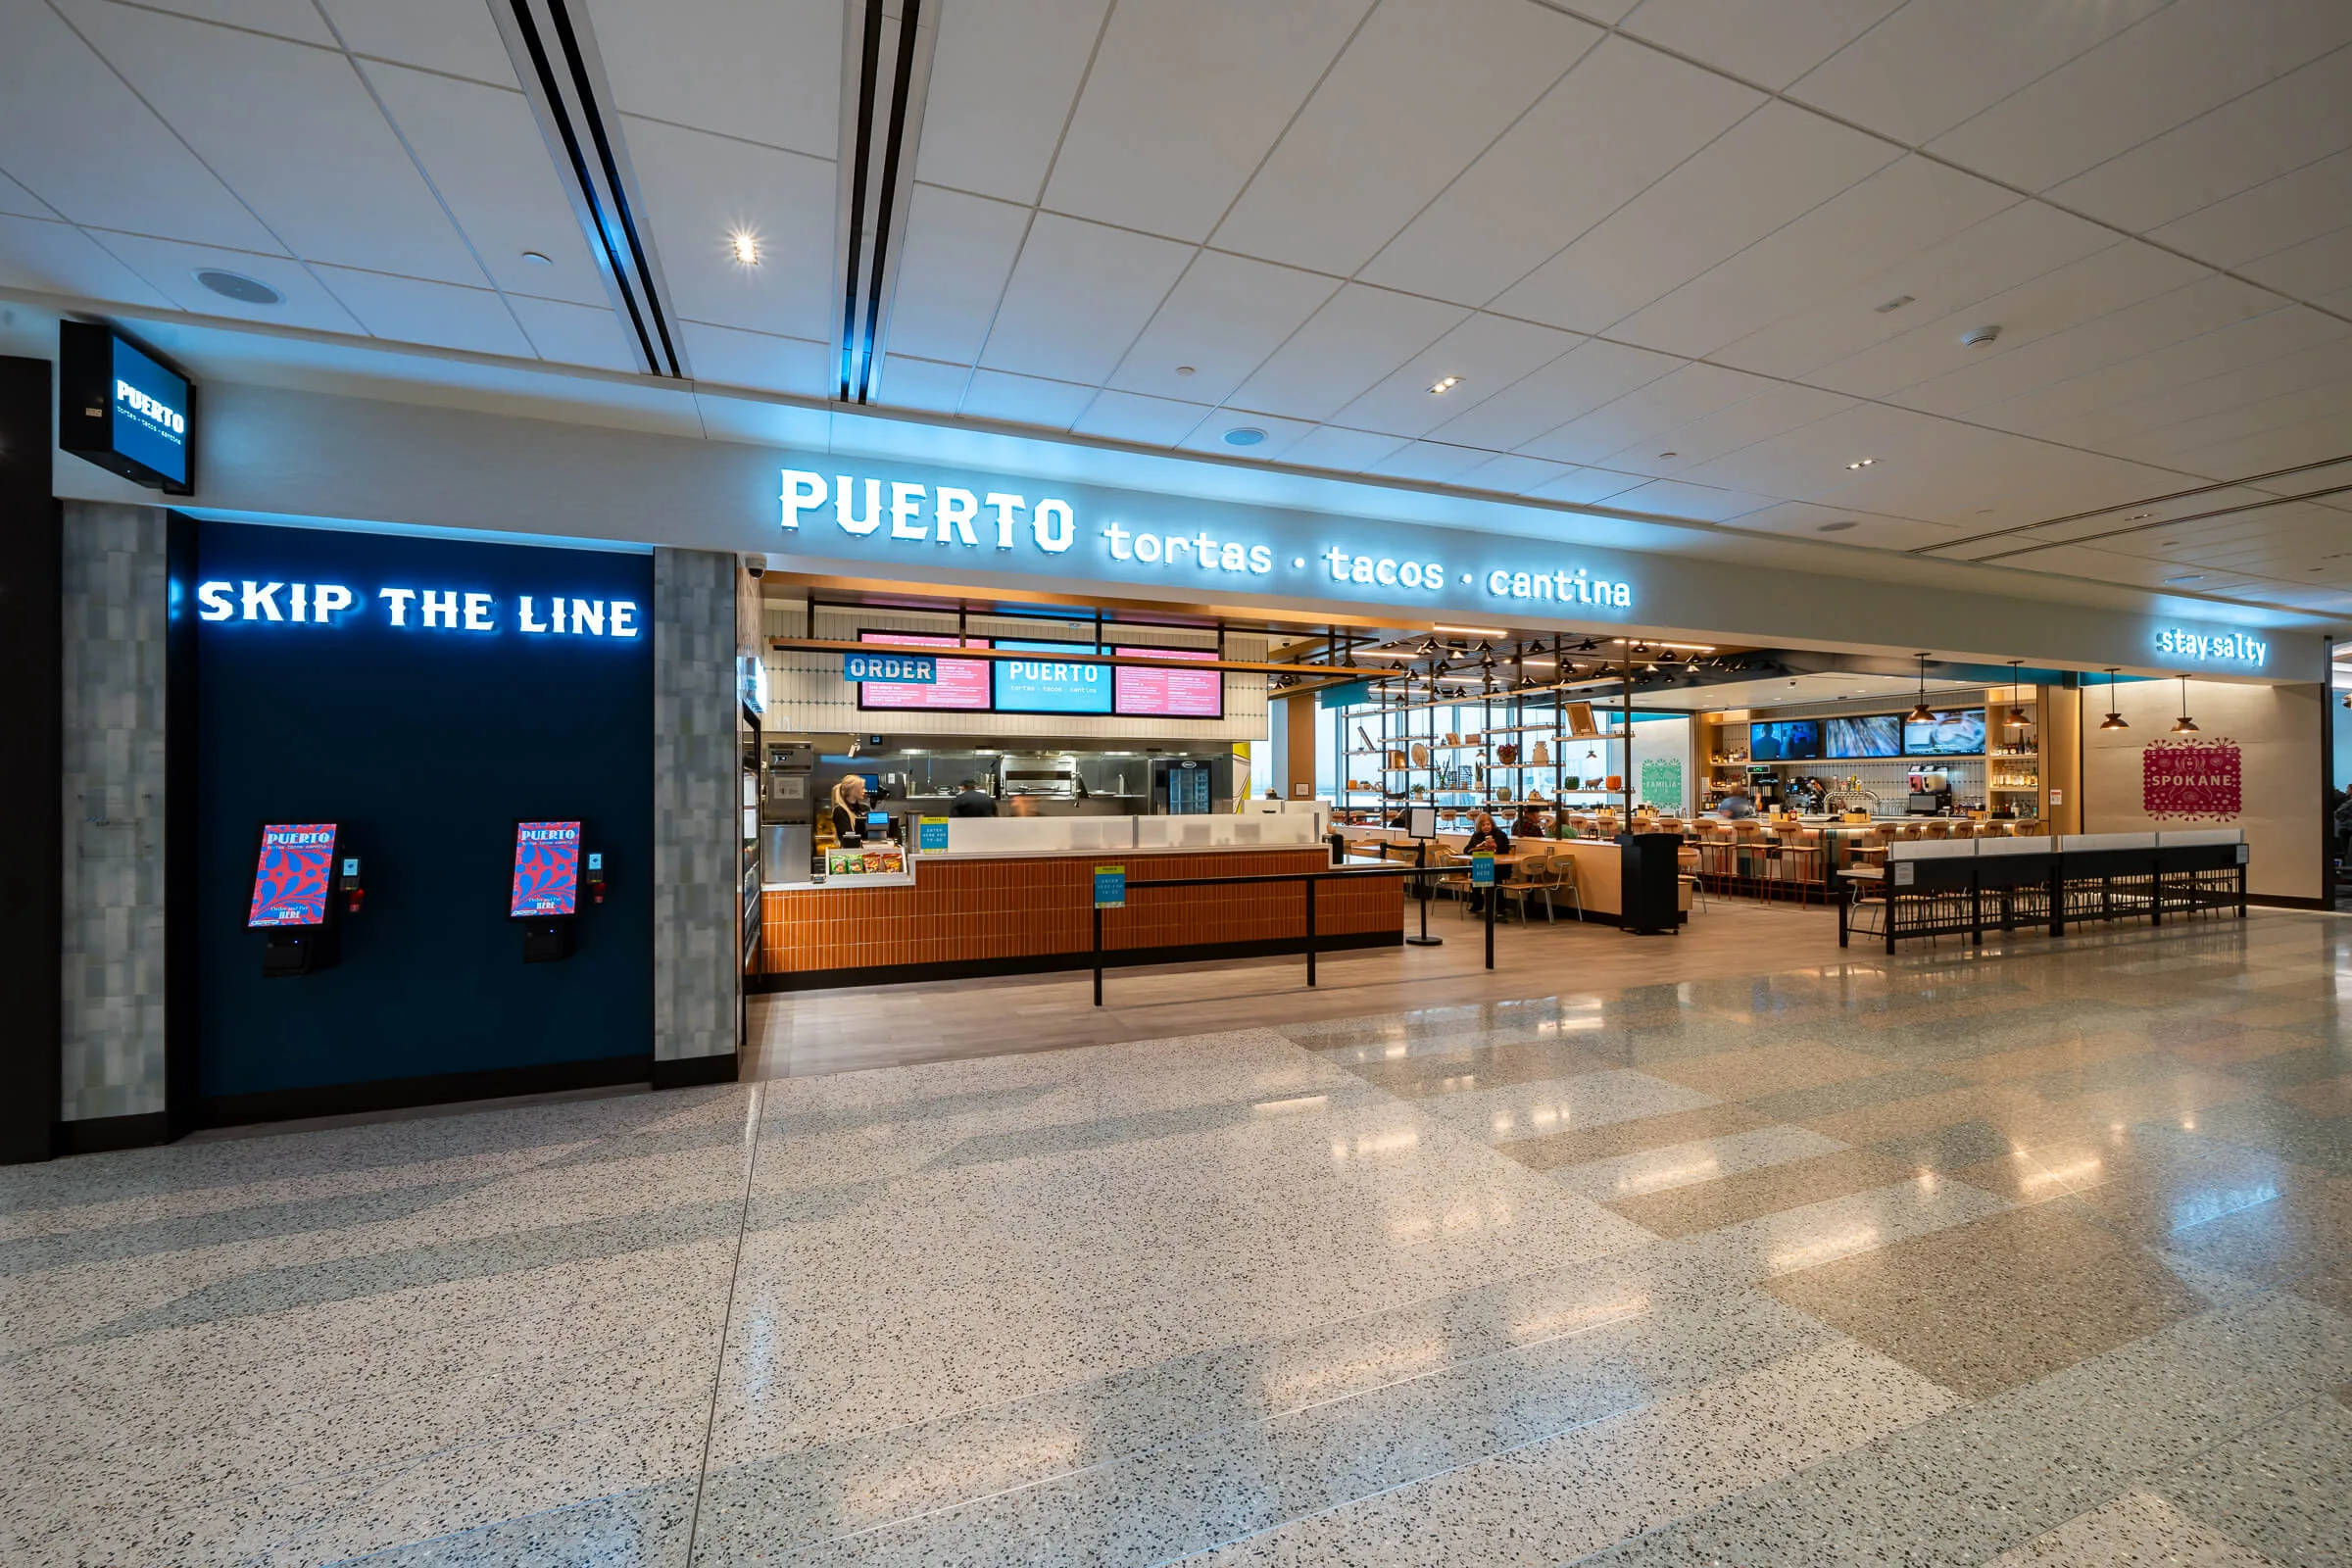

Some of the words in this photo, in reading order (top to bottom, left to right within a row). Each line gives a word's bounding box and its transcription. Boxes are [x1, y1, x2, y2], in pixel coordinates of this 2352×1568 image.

[117, 379, 184, 433] PUERTO
[778, 468, 1077, 553] PUERTO
[1102, 522, 1273, 574] tortas
[1323, 546, 1445, 590] tacos
[1487, 567, 1633, 608] cantina
[198, 580, 353, 623] SKIP
[378, 588, 496, 631] THE
[518, 596, 638, 637] LINE
[2160, 627, 2209, 662] stay
[2213, 632, 2267, 667] salty
[850, 658, 932, 680] ORDER
[1009, 662, 1099, 683] PUERTO
[2151, 775, 2232, 787] SPOKANE
[267, 832, 330, 845] PUERTO
[521, 830, 575, 841] PUERTO
